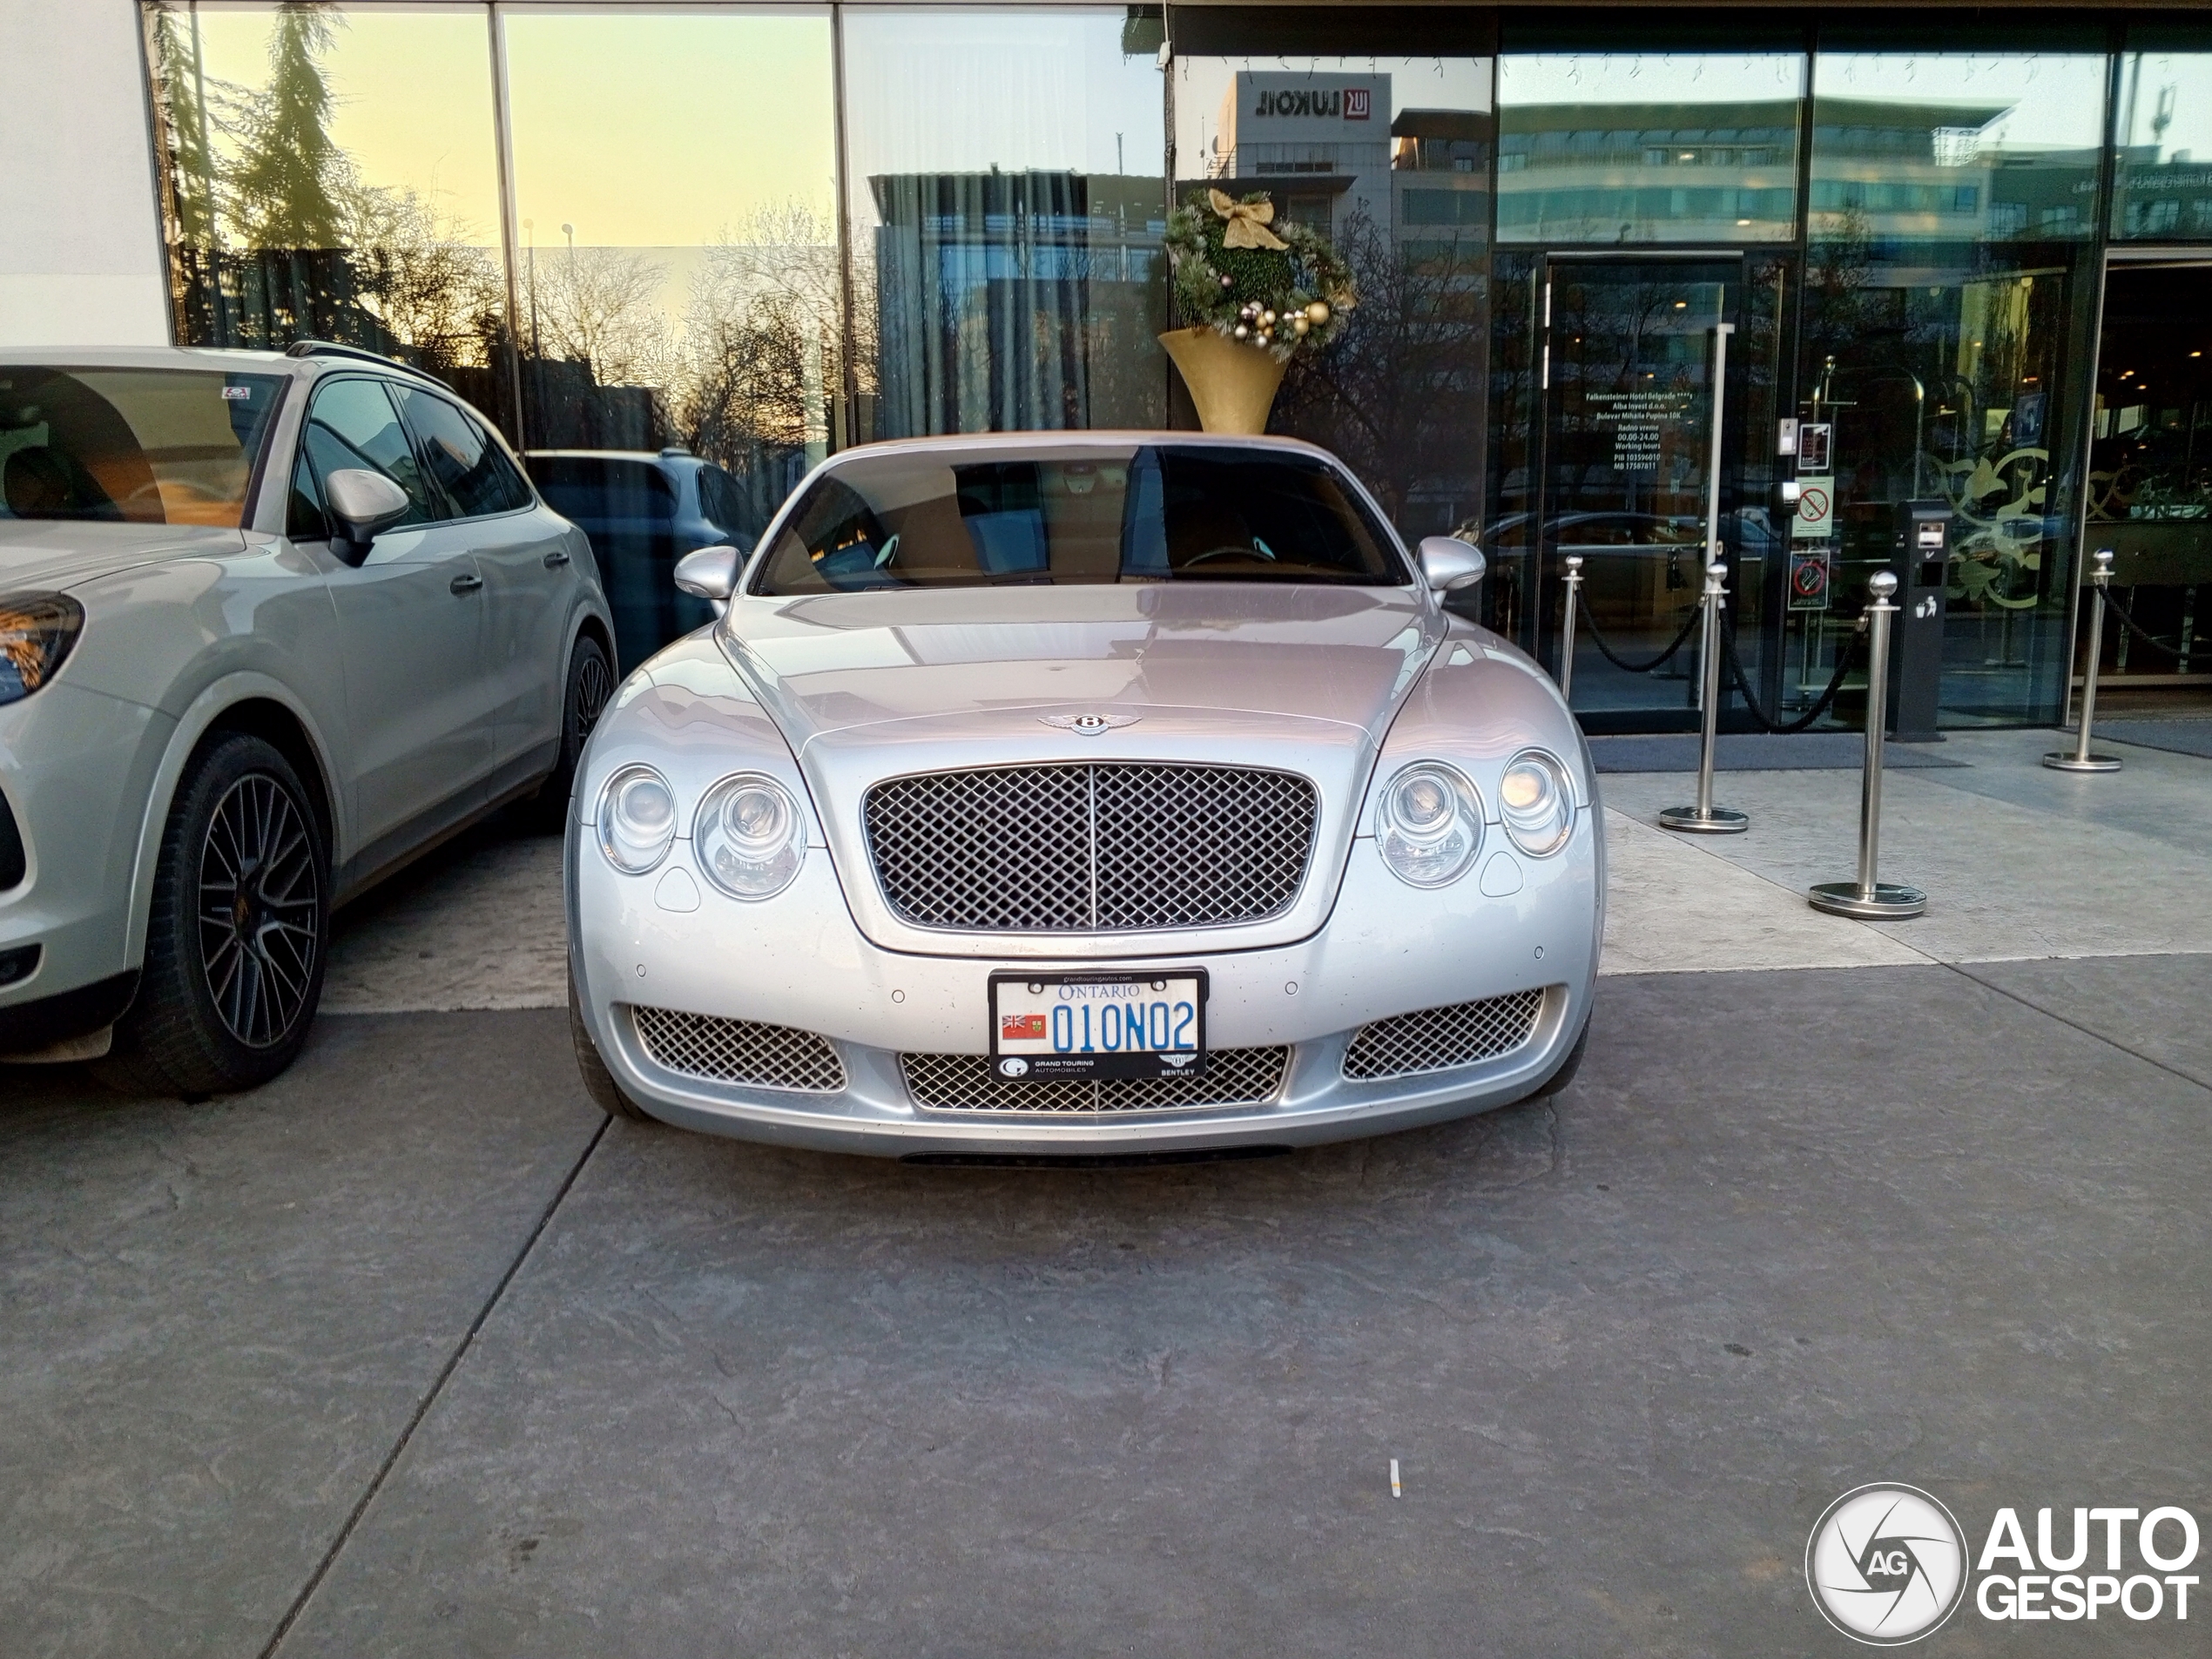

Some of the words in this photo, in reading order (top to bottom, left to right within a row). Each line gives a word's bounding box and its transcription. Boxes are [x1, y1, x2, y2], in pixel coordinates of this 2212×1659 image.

[1648, 392, 1676, 401] Belgrade
[1645, 412, 1668, 421] Pupina
[1615, 442, 1642, 451] Working
[1642, 442, 1661, 450] hours
